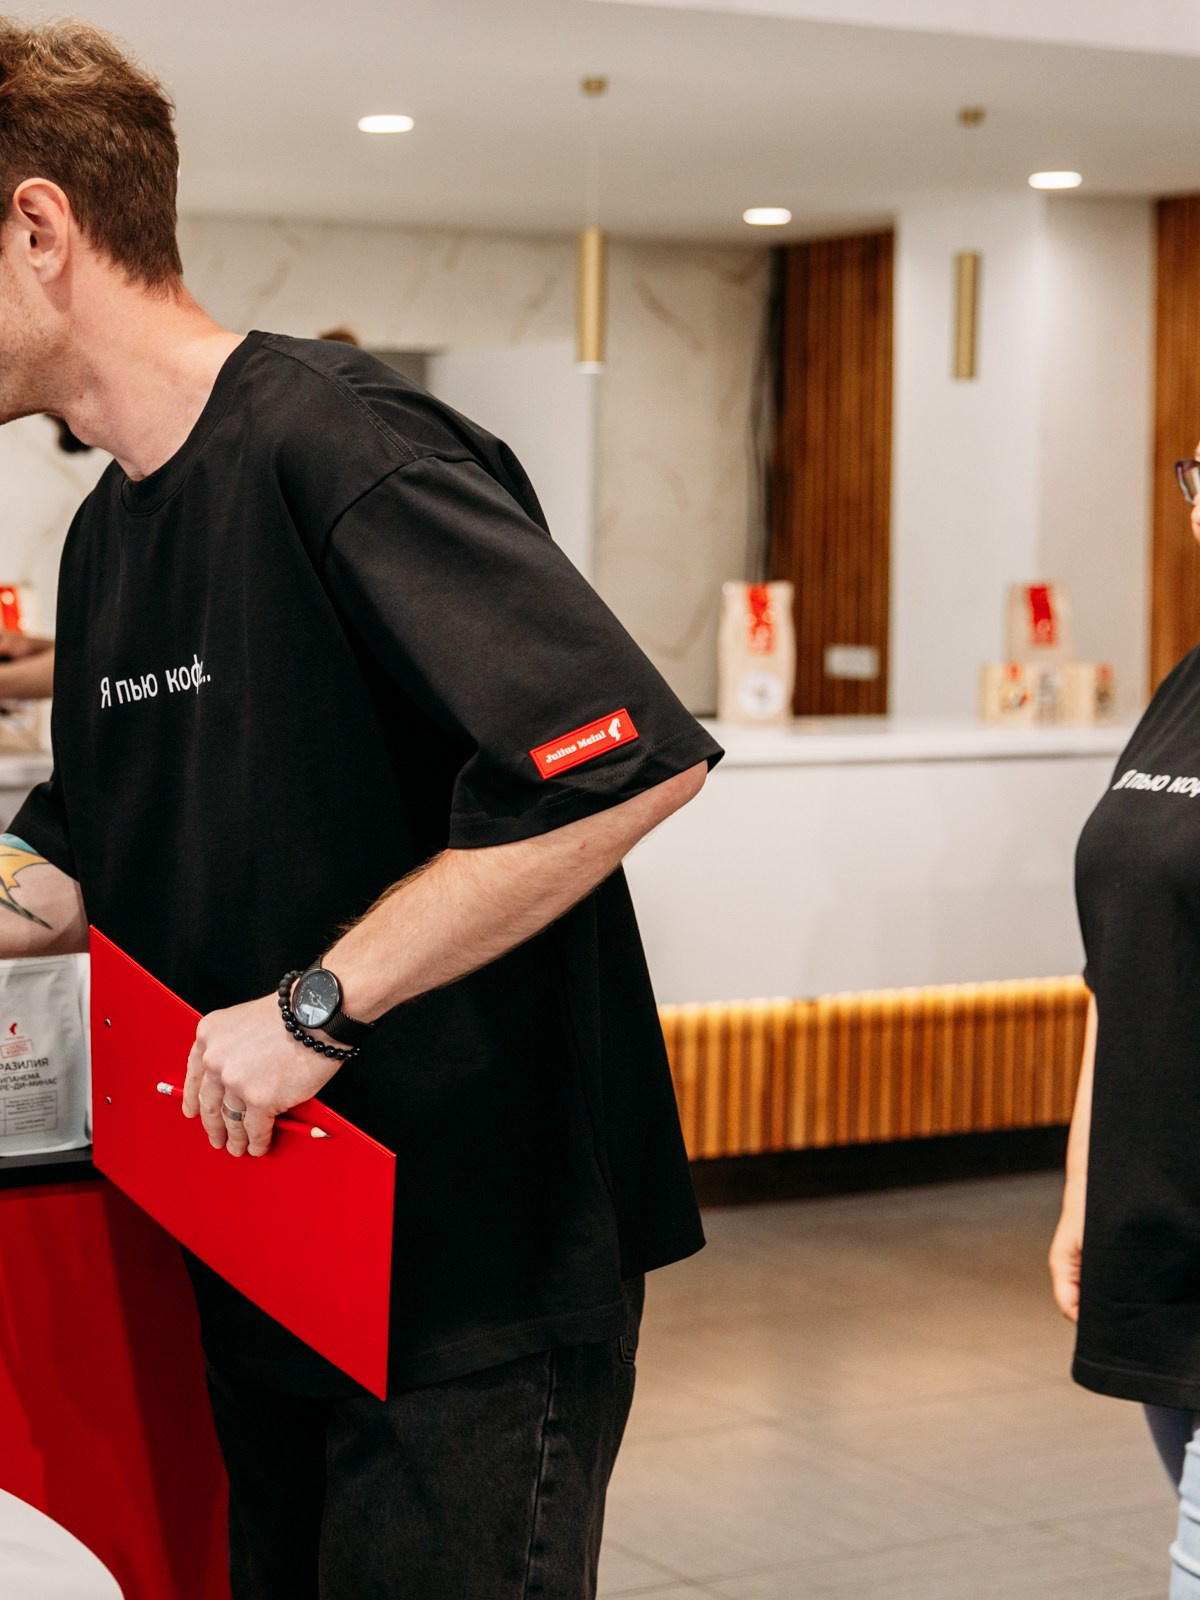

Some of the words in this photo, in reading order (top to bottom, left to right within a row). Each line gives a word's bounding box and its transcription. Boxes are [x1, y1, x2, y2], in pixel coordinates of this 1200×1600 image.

[100, 677, 112, 709] Я
[115, 673, 158, 704] пью
[545, 745, 577, 763] Julius
[576, 730, 607, 749] Meinl
